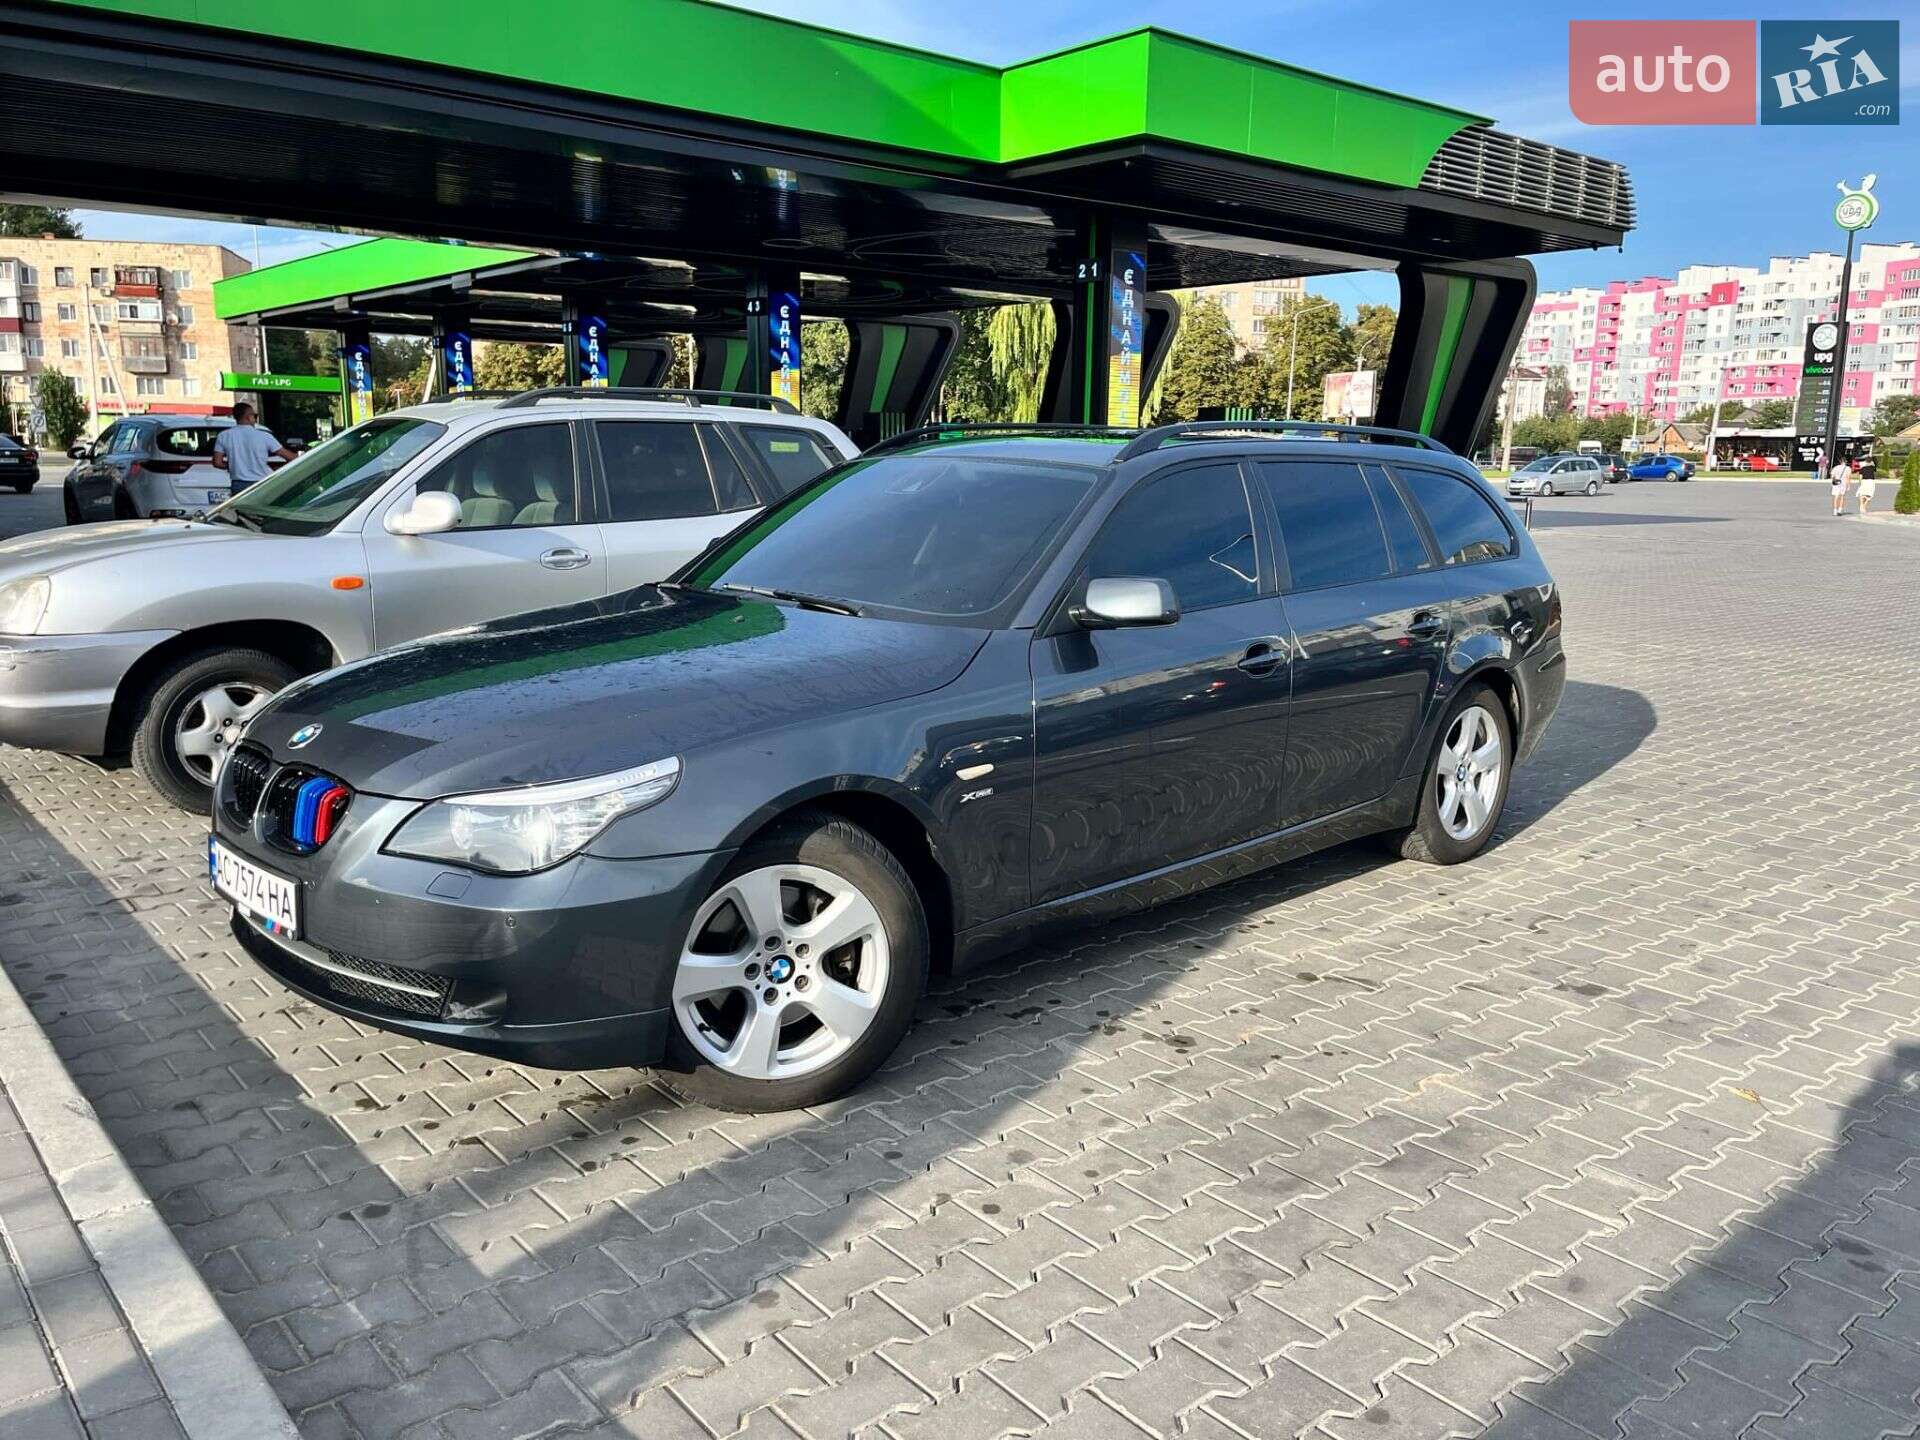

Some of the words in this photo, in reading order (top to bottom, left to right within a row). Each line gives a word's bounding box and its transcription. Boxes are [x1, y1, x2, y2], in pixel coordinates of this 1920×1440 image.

[1078, 264, 1086, 278] 2
[1091, 262, 1098, 277] 1
[1814, 352, 1833, 363] upg
